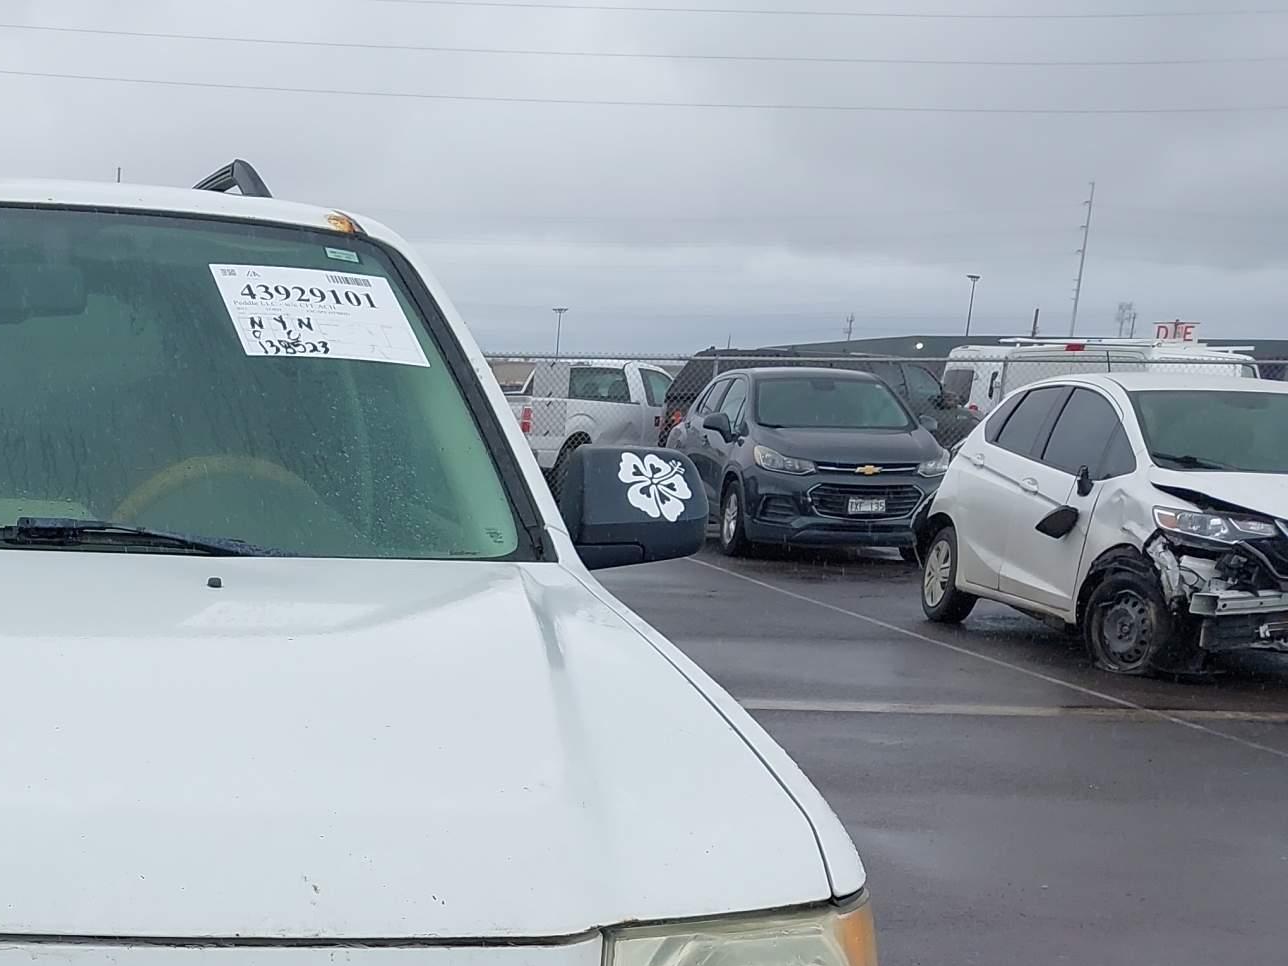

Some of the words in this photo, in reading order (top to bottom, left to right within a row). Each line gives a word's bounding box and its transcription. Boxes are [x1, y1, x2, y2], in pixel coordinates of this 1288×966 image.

[240, 283, 377, 309] 43929101
[250, 316, 264, 329] N
[273, 315, 287, 331] Y
[297, 317, 314, 331] N
